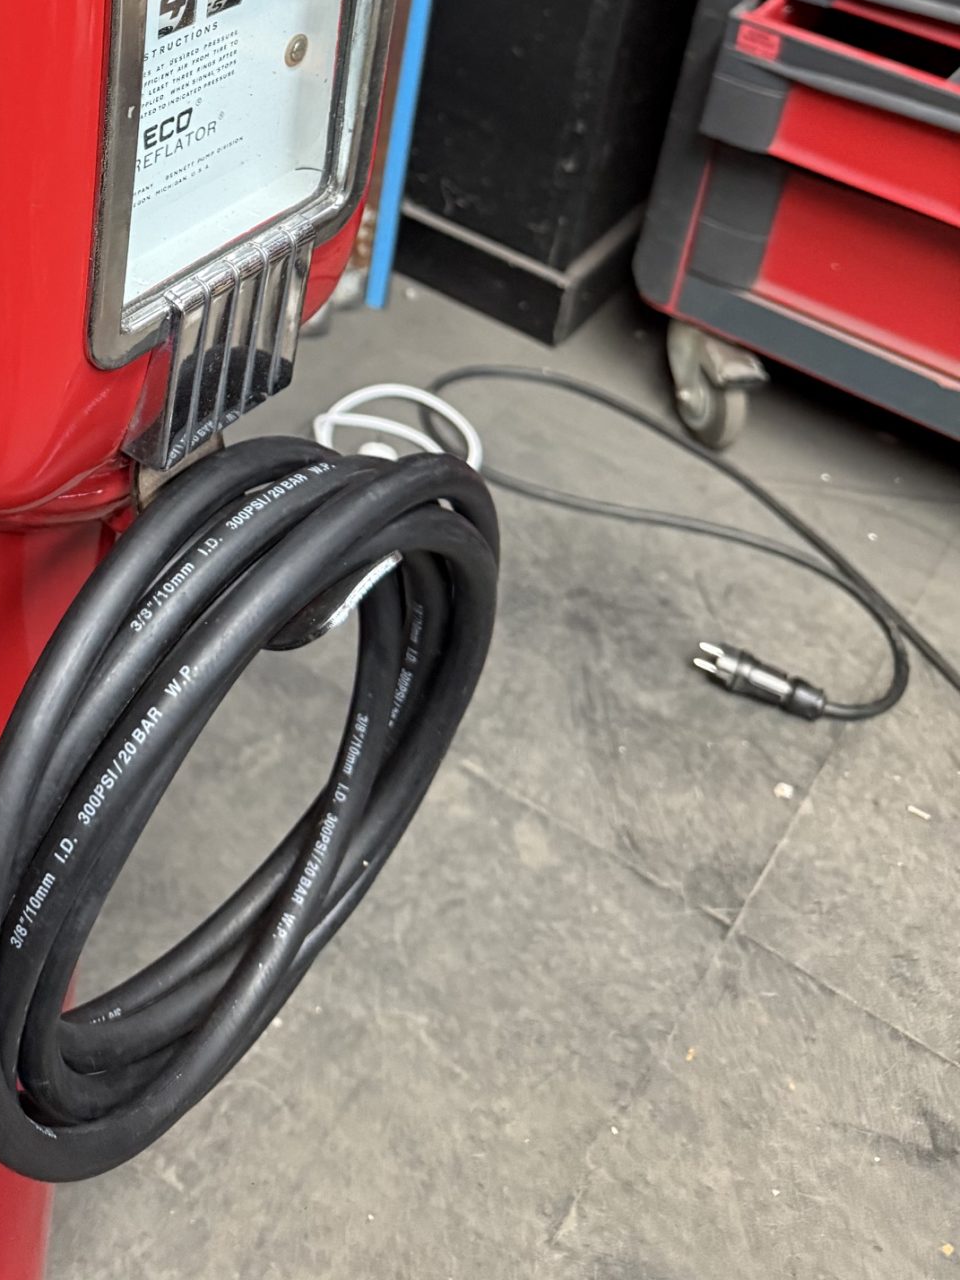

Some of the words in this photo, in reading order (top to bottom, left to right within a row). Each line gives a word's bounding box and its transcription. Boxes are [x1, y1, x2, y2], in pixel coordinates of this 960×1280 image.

[169, 48, 200, 66] DESIRED
[203, 30, 238, 50] PRESSURE
[177, 63, 188, 73] AIR
[192, 53, 209, 65] FROM
[230, 39, 238, 47] TO
[148, 82, 169, 95] LEAST
[173, 70, 193, 84] THREE
[197, 535, 223, 557] I.D.
[54, 836, 78, 865] I.D.
[164, 662, 200, 700] W.P.
